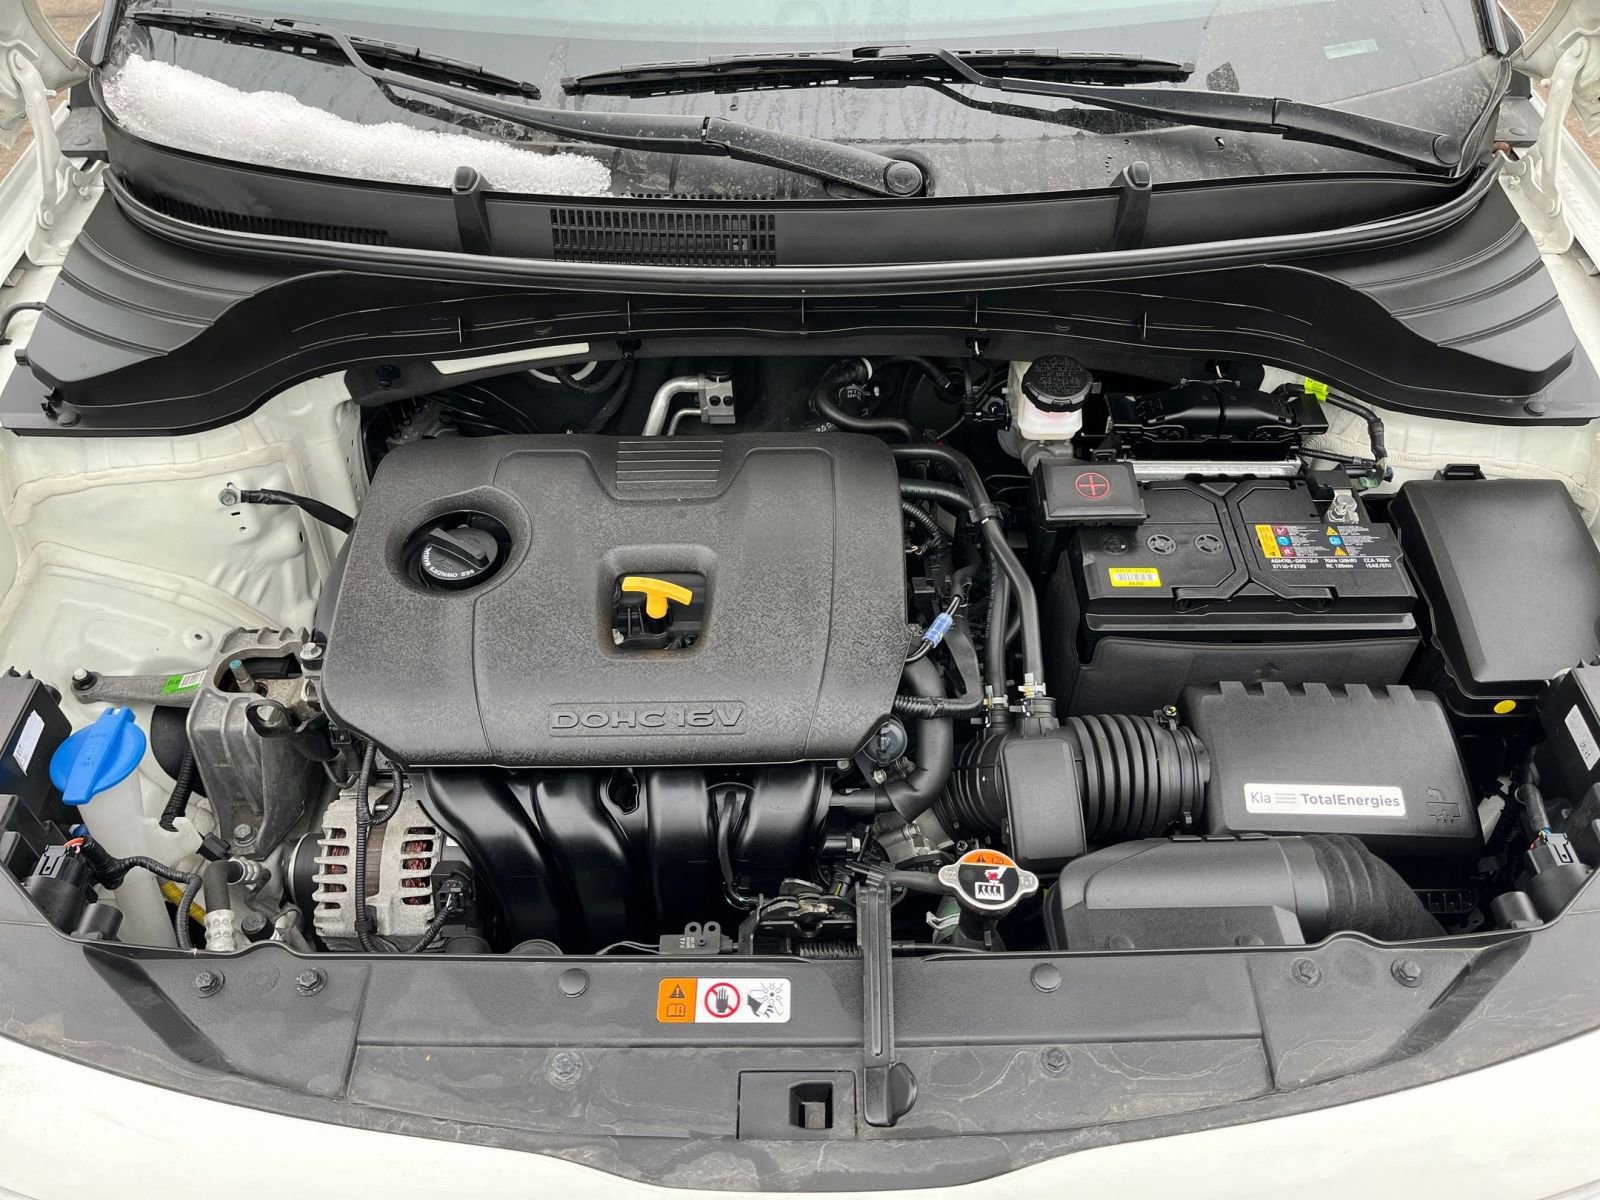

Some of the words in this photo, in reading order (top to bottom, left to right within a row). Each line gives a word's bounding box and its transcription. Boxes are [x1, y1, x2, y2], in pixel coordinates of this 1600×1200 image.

[422, 546, 433, 567] MANUAL
[460, 568, 475, 577] SEE
[551, 710, 666, 730] DOHC
[671, 708, 744, 728] 16V
[1250, 791, 1271, 804] Kia
[1300, 793, 1401, 808] TotalEnergies
